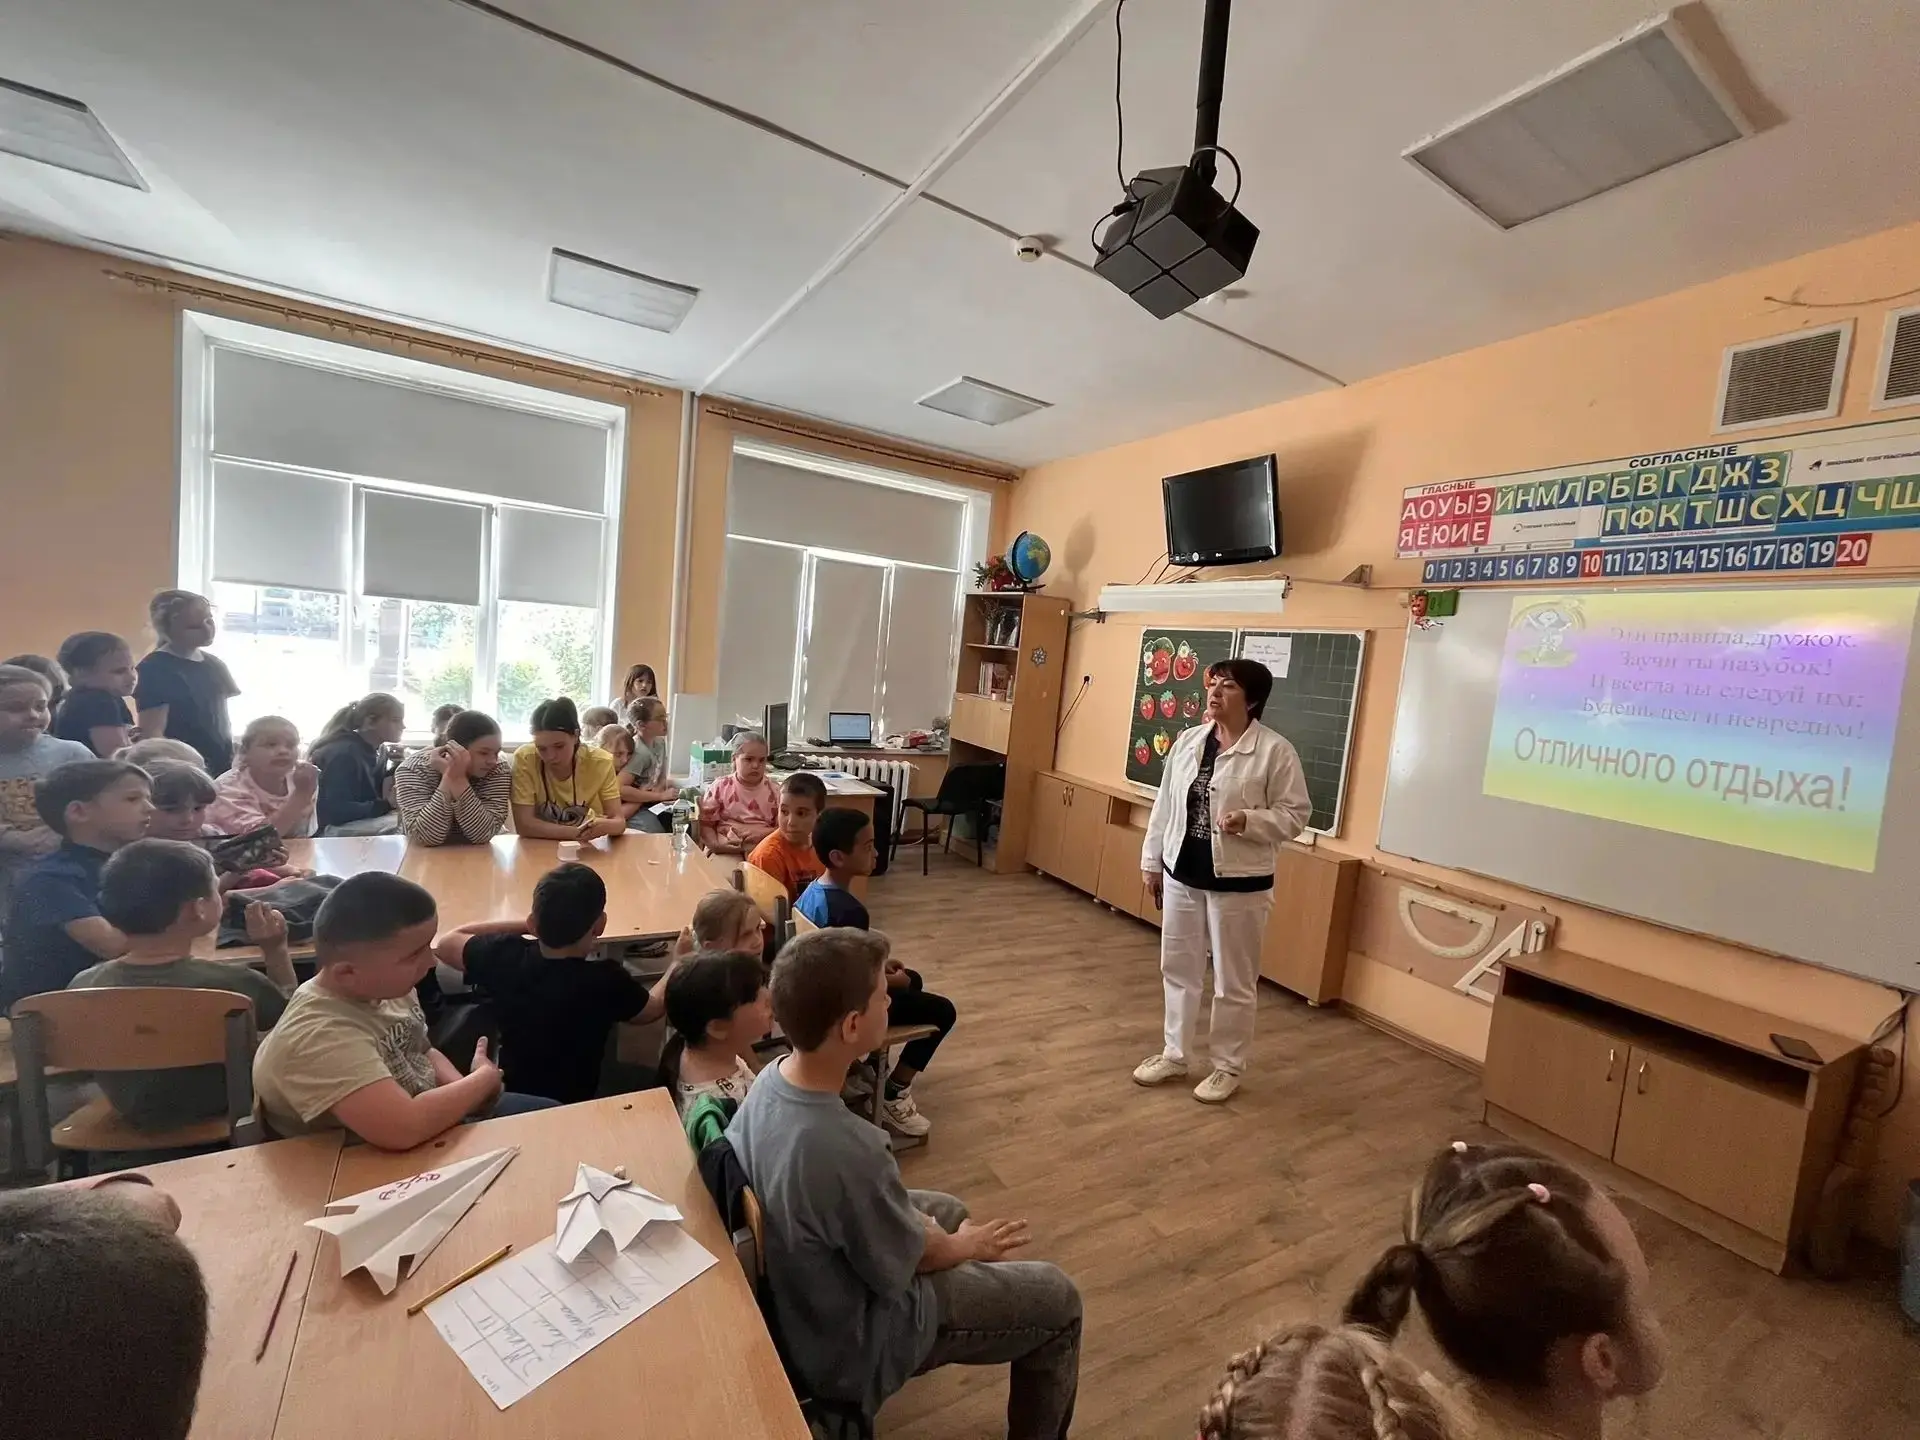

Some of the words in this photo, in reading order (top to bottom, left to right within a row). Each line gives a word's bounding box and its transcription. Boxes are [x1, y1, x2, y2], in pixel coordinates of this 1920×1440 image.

[1629, 445, 1738, 468] СОГЛАСНЫЕ
[1422, 481, 1476, 495] ГЛАСНЫЕ
[1425, 564, 1434, 580] 0
[1440, 563, 1447, 579] 1
[1452, 562, 1462, 579] 2
[1467, 561, 1477, 578] 3
[1483, 560, 1493, 577] 4
[1498, 560, 1508, 576] 5
[1514, 559, 1525, 576] 6
[1531, 558, 1541, 575] 7
[1547, 557, 1559, 575] 8
[1566, 555, 1577, 574] 9
[1583, 554, 1600, 573] 10
[1605, 553, 1621, 573] 11
[1627, 552, 1646, 572] 12
[1650, 550, 1668, 570] 13
[1674, 549, 1694, 569] 14
[1699, 547, 1721, 568] 15
[1725, 546, 1747, 567] 16
[1752, 544, 1776, 566] 17
[1780, 542, 1804, 565] 18
[1809, 540, 1835, 563] 19
[1837, 539, 1868, 562] 20
[1620, 650, 1676, 671] Заучи
[1687, 658, 1712, 670] ты
[1721, 656, 1832, 677] назубок!
[1611, 678, 1675, 695] всегда
[1685, 683, 1711, 696] ты
[1719, 685, 1805, 706] следуй
[1660, 707, 1698, 723] цел
[1706, 712, 1718, 725] и
[1727, 713, 1865, 740] невредим!
[1514, 727, 1676, 784] Отличного
[1687, 757, 1852, 812] отдыха!
